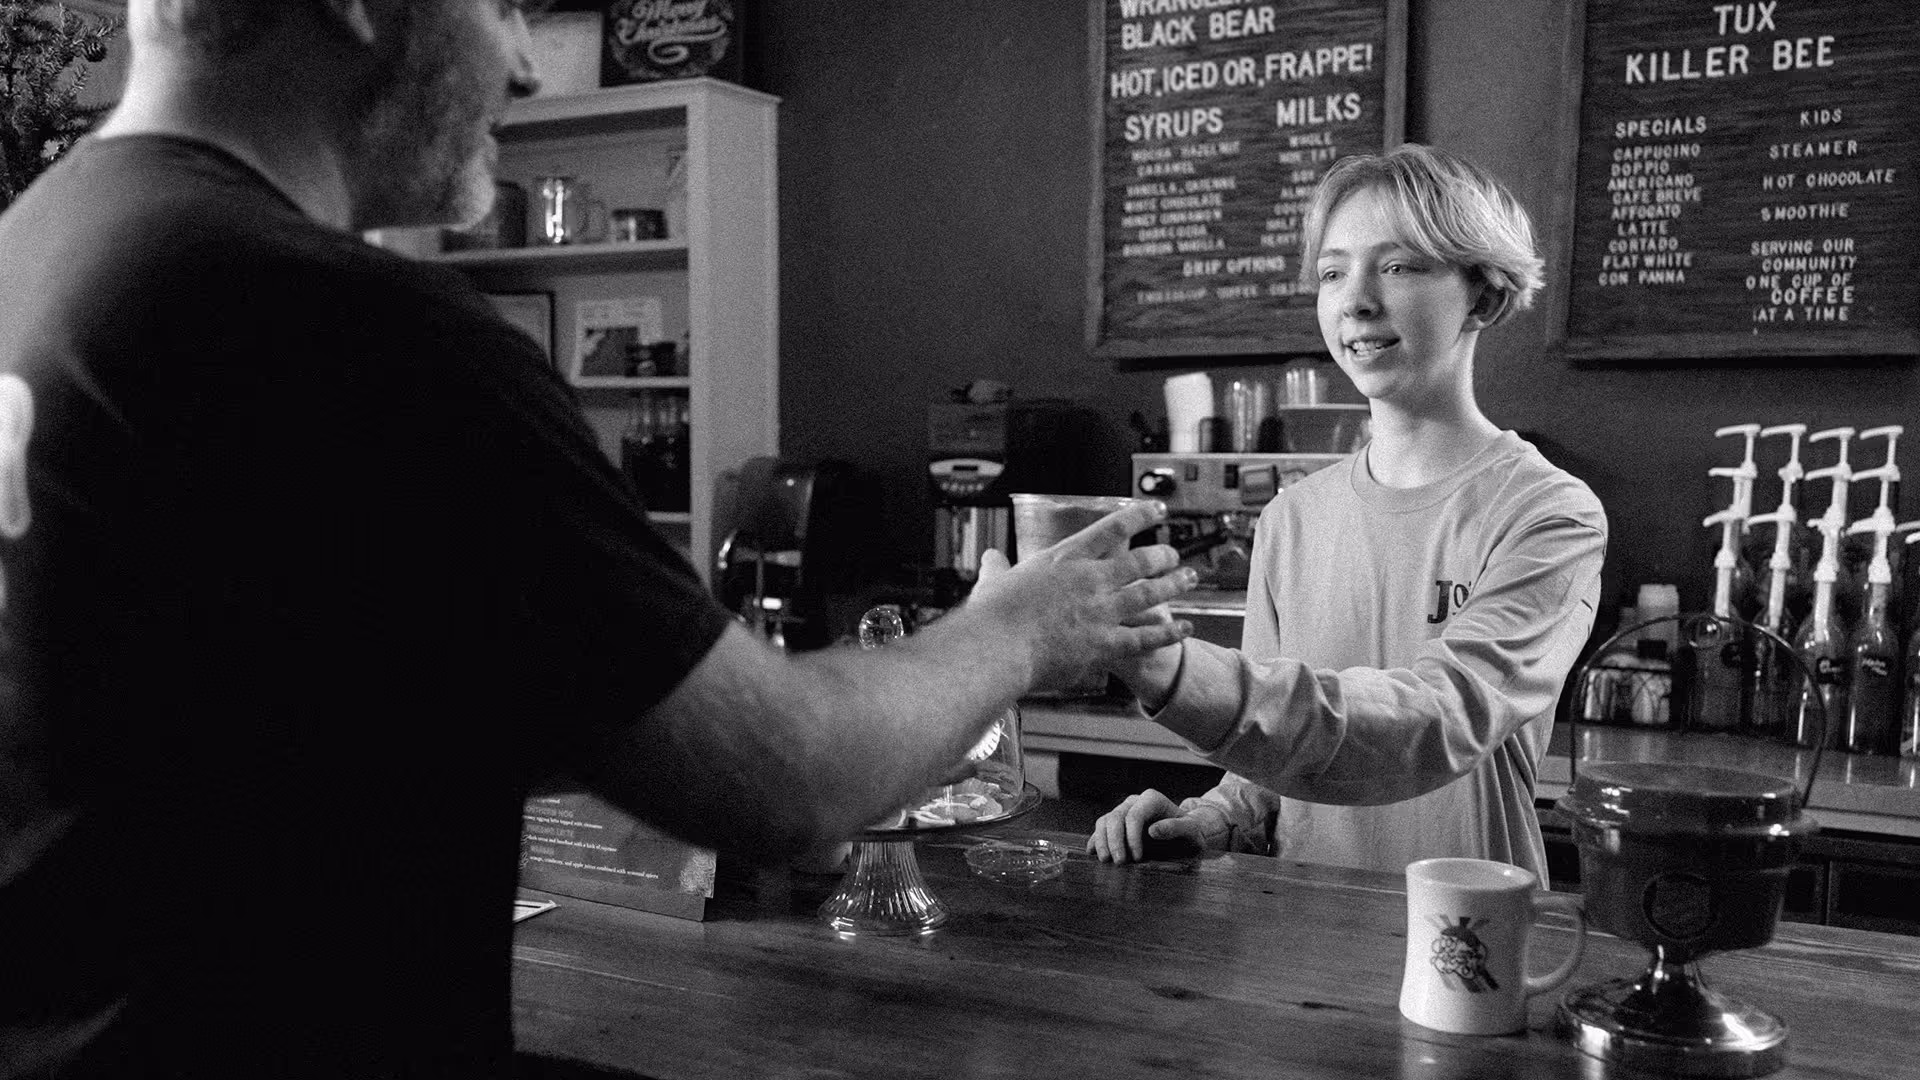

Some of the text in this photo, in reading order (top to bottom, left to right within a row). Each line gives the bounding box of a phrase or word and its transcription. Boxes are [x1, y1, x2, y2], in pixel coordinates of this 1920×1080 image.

[1121, 6, 1275, 51] BLACK BEAR
[1713, 1, 1777, 36] TUX
[1625, 35, 1834, 84] KILLER BEE
[1276, 92, 1361, 128] MILKS
[1799, 108, 1842, 126] KIDS
[1124, 107, 1224, 142] SYRUPS
[1615, 115, 1707, 139] SPECIALS
[1613, 142, 1701, 163] CAPPUCINO
[1769, 140, 1858, 160] STEAMER
[1611, 160, 1670, 177] DOPPIO
[1607, 173, 1695, 192] AMERICANO
[1762, 167, 1896, 191] HOT CHOCOLATE
[1611, 203, 1681, 220] AFFOGATO
[1760, 202, 1851, 222] SMOOTHIE
[1617, 219, 1668, 237] LATTE
[1608, 236, 1679, 254] CORTADO
[1750, 237, 1854, 256] SERVING OUR
[1602, 250, 1694, 270] FLAT WHITE
[1762, 255, 1858, 273] COMMUNITY
[1598, 270, 1629, 287] CON
[1745, 271, 1853, 290] ONE CUP OF
[1771, 285, 1855, 306] COFFEE
[1758, 304, 1849, 323] AT A TIME
